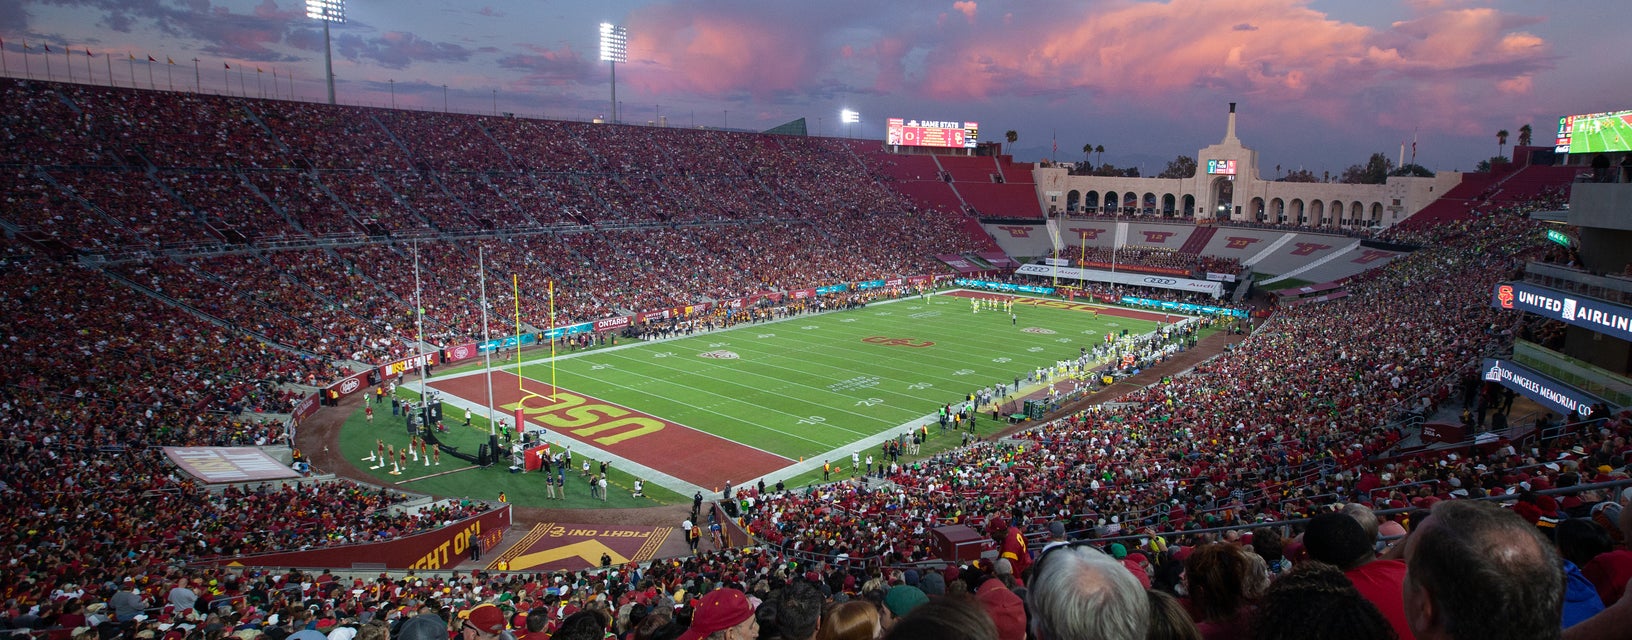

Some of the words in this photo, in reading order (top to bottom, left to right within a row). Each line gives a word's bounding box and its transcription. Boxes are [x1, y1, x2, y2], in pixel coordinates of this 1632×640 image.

[921, 120, 940, 128] GAME
[940, 121, 959, 129] STATS
[1519, 290, 1562, 312] UNITED
[598, 316, 628, 328] ONTARIO
[385, 358, 413, 376] MUSCLE
[1501, 367, 1513, 381] LOS
[1512, 374, 1540, 394] ANGELES
[854, 397, 884, 407] 20
[498, 392, 666, 446] USC
[796, 415, 826, 425] 10
[567, 528, 597, 537] ON!
[599, 529, 651, 538] FIGHT
[407, 540, 451, 571] GHT
